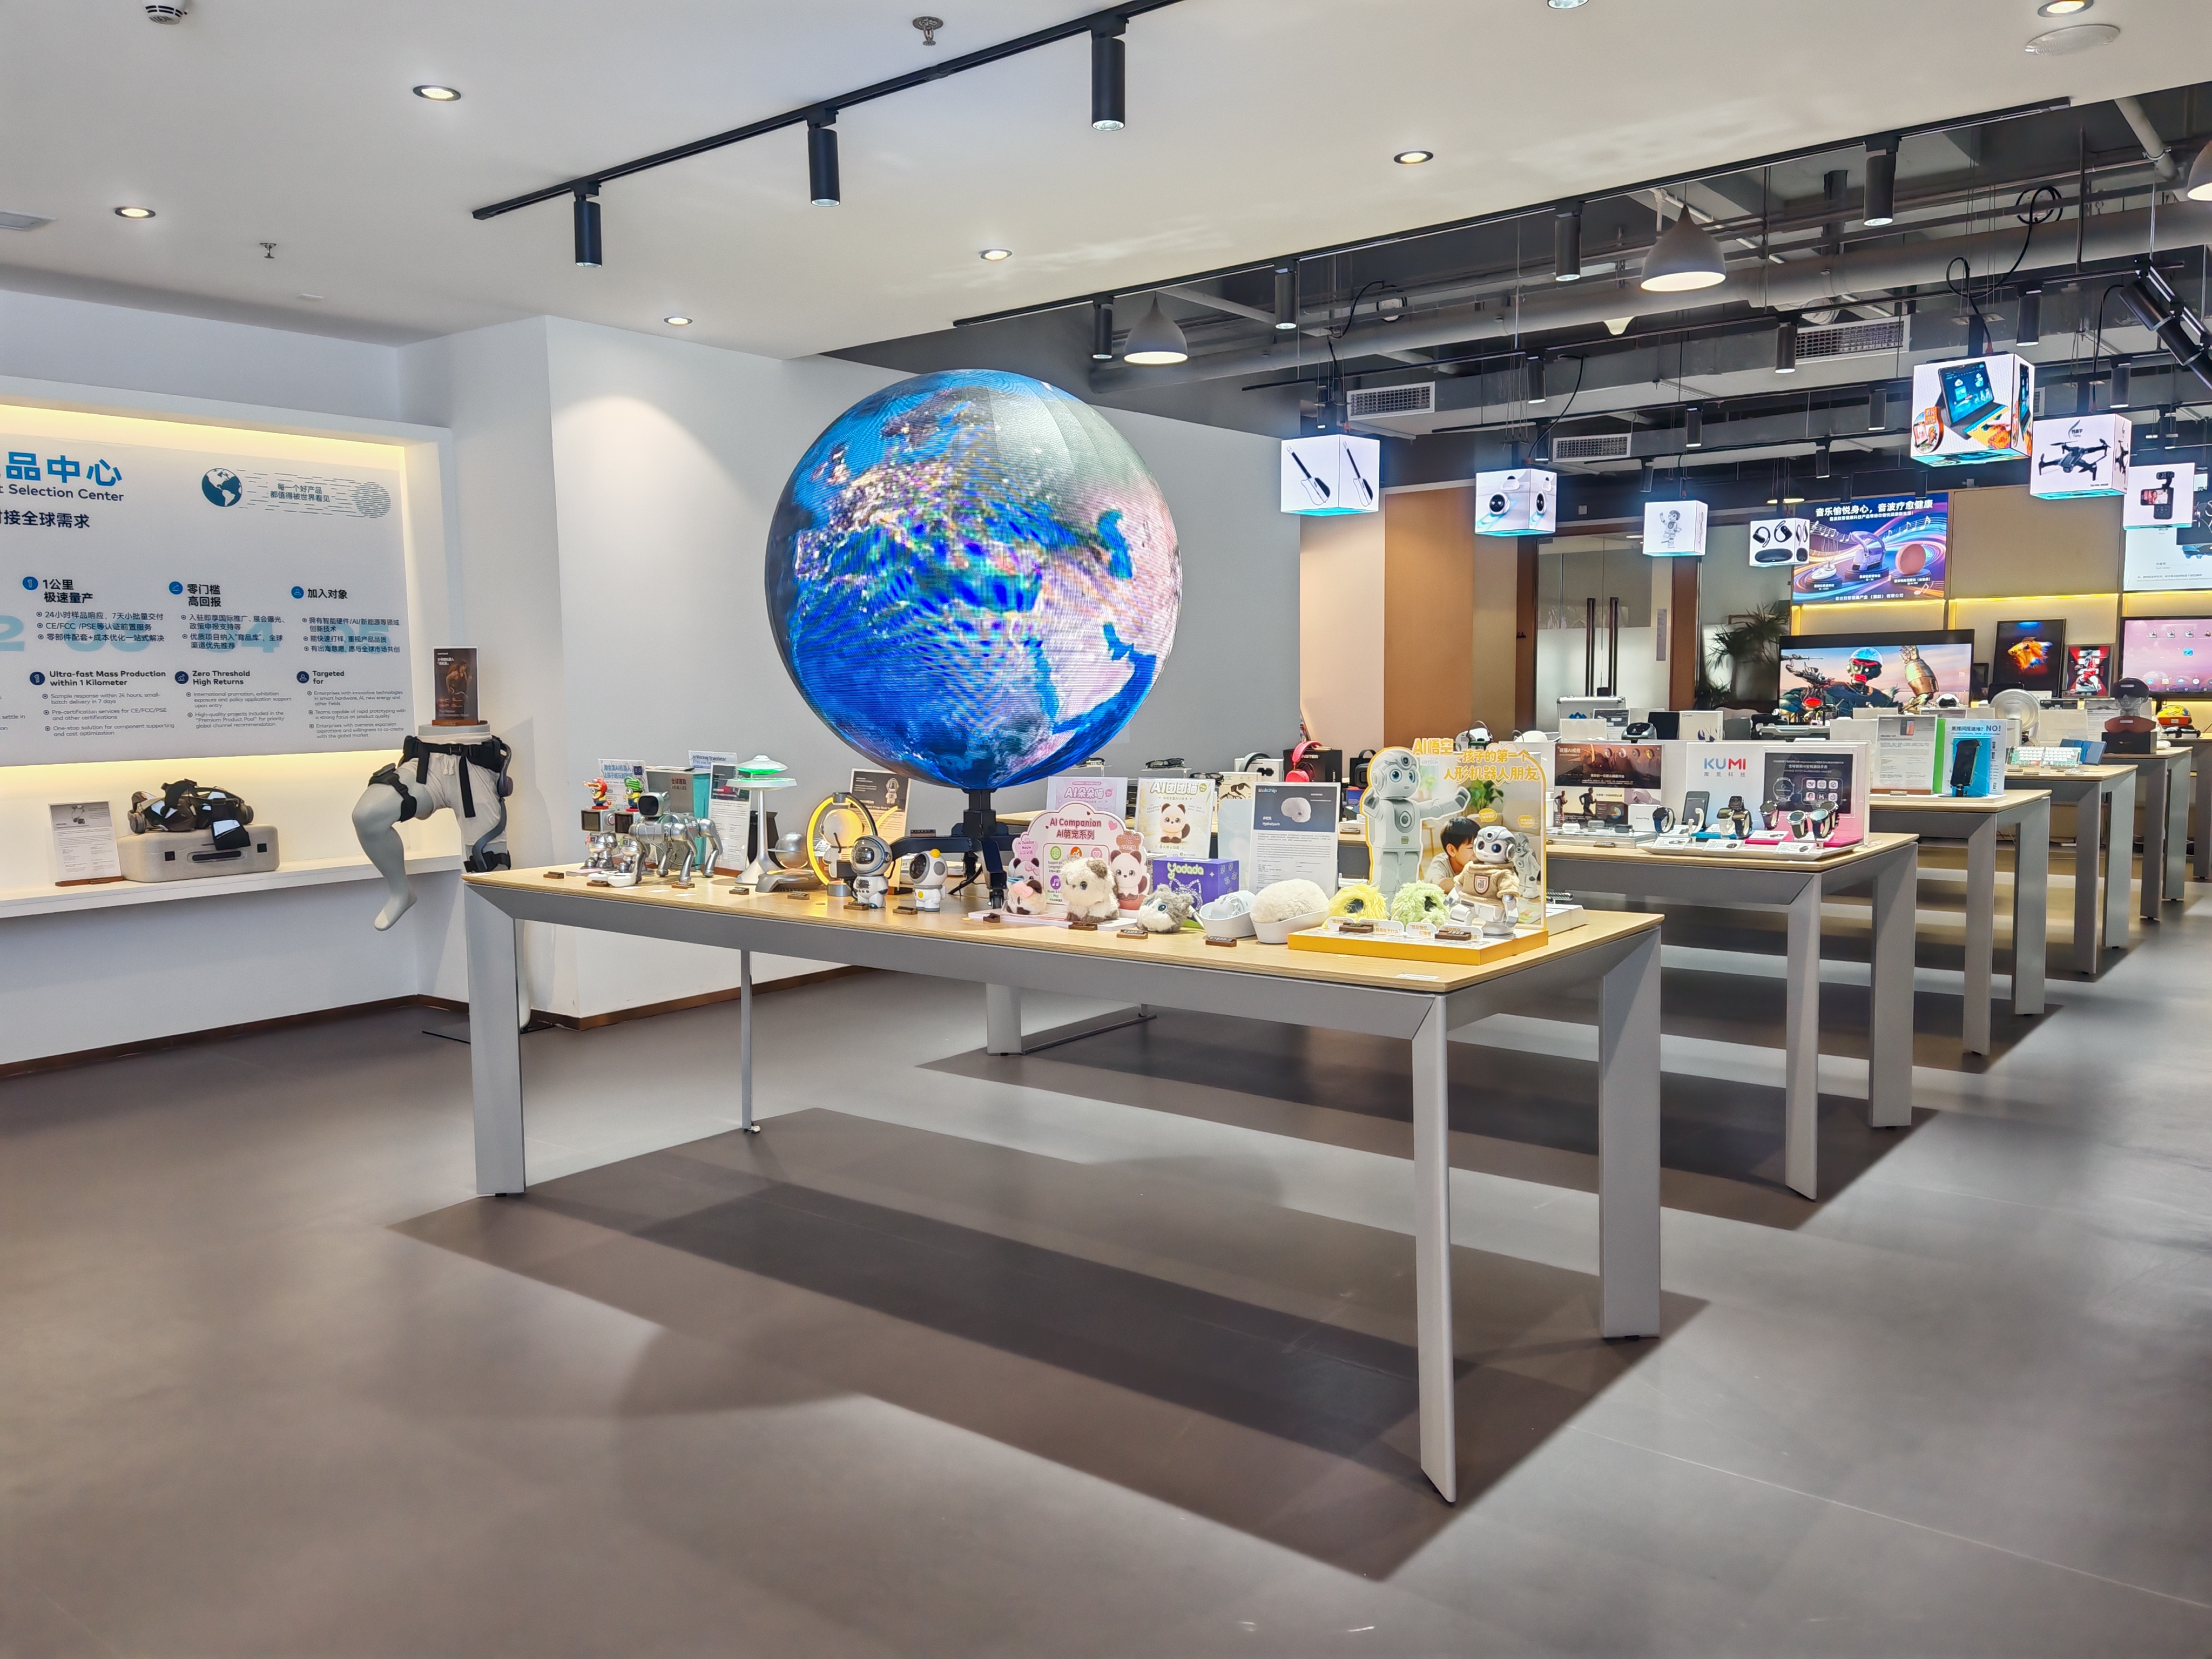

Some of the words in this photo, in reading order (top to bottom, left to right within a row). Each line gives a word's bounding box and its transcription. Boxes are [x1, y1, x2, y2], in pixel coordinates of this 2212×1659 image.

[5, 451, 122, 487] 品中心
[9, 484, 73, 499] Selection
[78, 489, 124, 501] Center
[278, 483, 322, 494] 每一个好产品
[271, 491, 330, 502] 都值得被世界看见
[1816, 499, 1933, 517] 音乐愉悦身心，音波疗愈健康
[43, 579, 73, 590] 1公里
[187, 584, 221, 595] 零门槛
[44, 592, 93, 603] 极速量产
[307, 589, 348, 599] 加入对象
[188, 596, 221, 607] 高回报
[1412, 738, 1453, 756] AI悟空
[1704, 758, 1746, 770] KUMI
[1444, 766, 1540, 781] 人形机器人朋友
[1064, 787, 1104, 799] AI朵朵喵
[1150, 781, 1199, 795] AI团团猫
[1050, 818, 1057, 827] AI
[1060, 818, 1102, 830] Companion
[1056, 828, 1095, 840] AI萌宠系列
